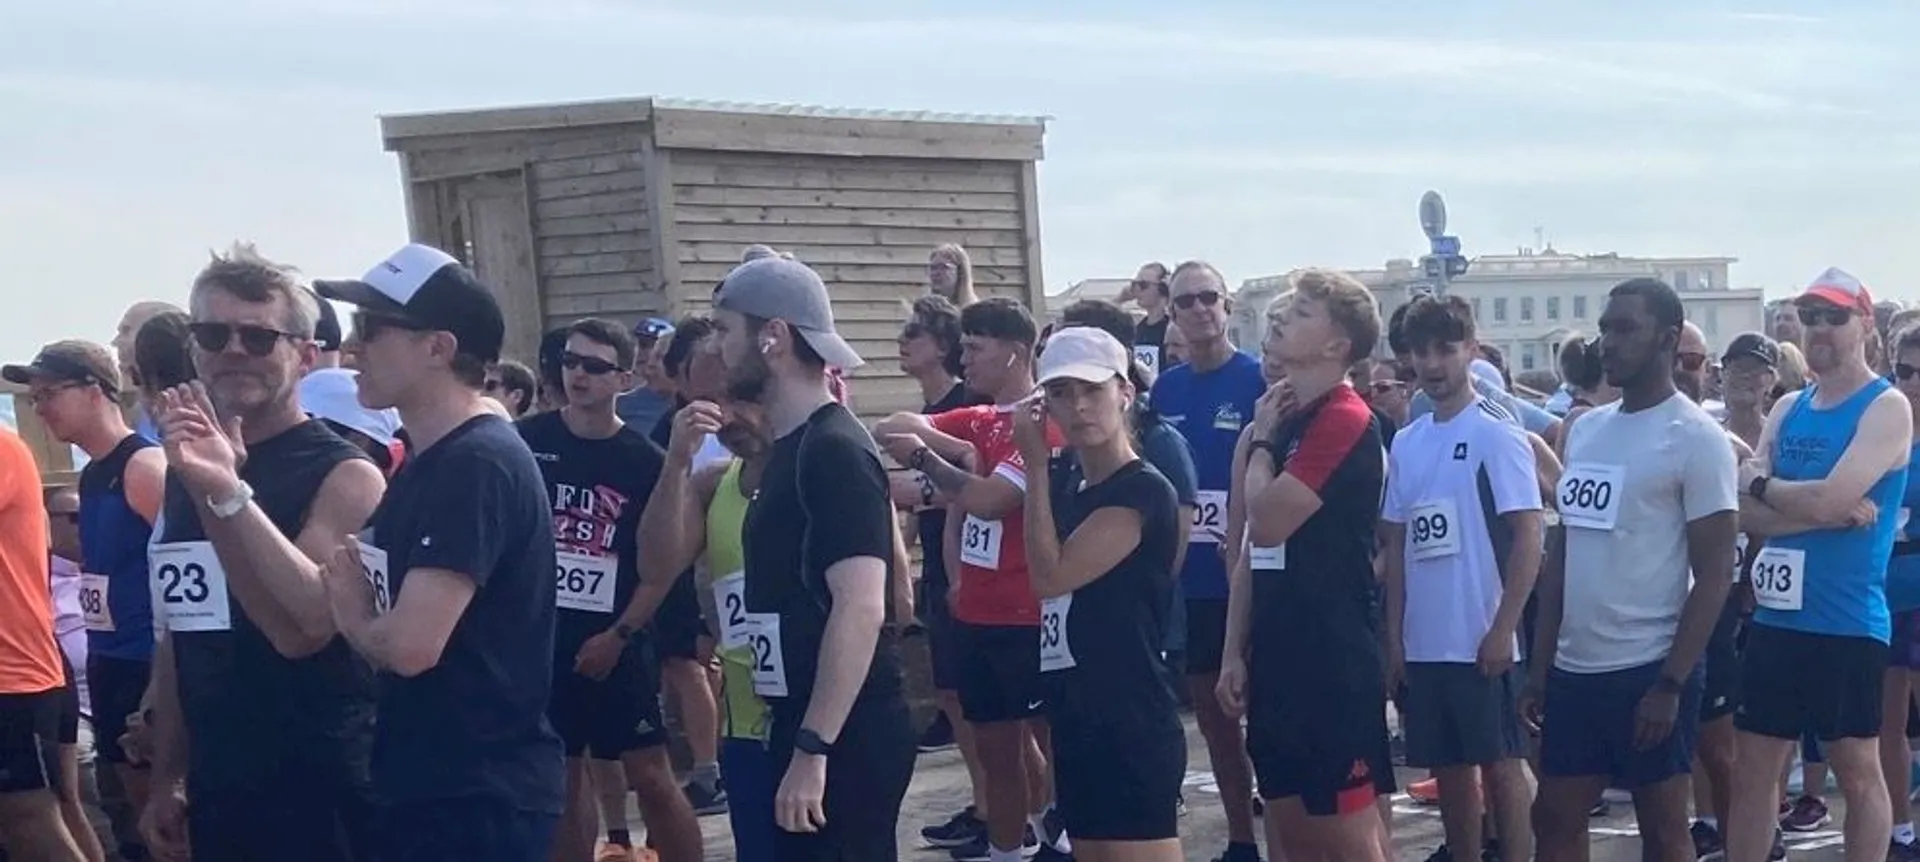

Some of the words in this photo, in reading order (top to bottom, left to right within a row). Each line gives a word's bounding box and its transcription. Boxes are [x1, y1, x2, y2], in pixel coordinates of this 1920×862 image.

[1562, 477, 1611, 511] 360
[158, 562, 209, 604] 23
[1755, 562, 1792, 592] 313
